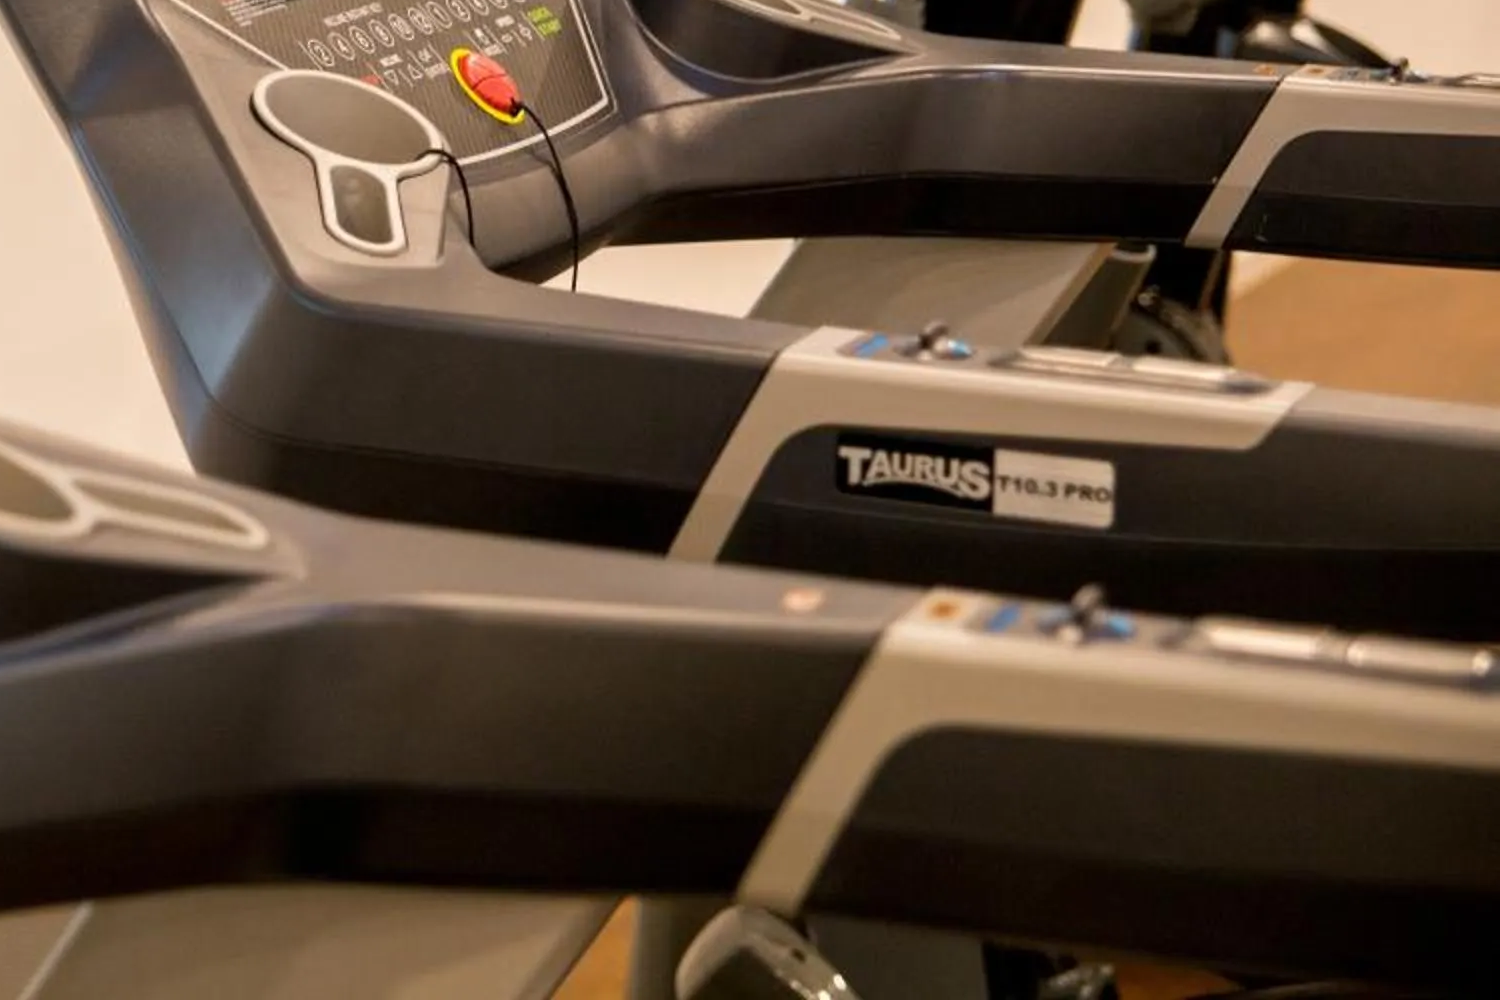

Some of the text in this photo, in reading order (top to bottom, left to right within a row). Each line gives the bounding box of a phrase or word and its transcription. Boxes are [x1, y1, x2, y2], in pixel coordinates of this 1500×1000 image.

[838, 446, 1112, 503] TAURUS T10.3 PRO
